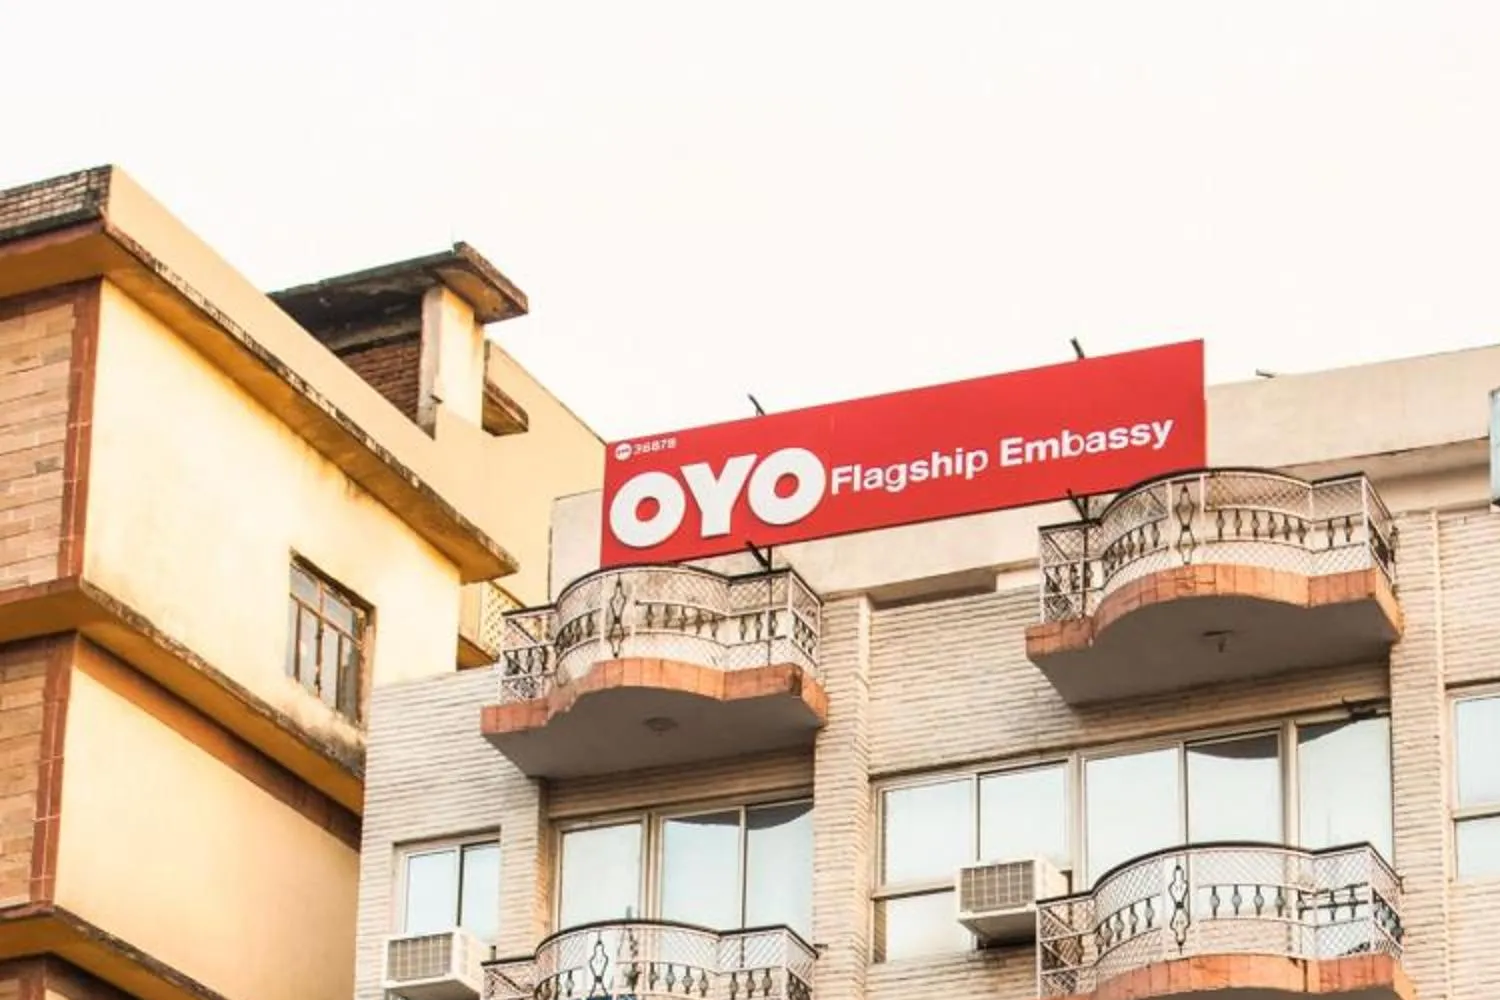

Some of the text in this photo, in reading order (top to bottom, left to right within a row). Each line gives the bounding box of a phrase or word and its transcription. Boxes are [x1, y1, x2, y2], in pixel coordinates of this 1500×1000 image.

[609, 419, 1174, 547] OYO Flagship Embassy
